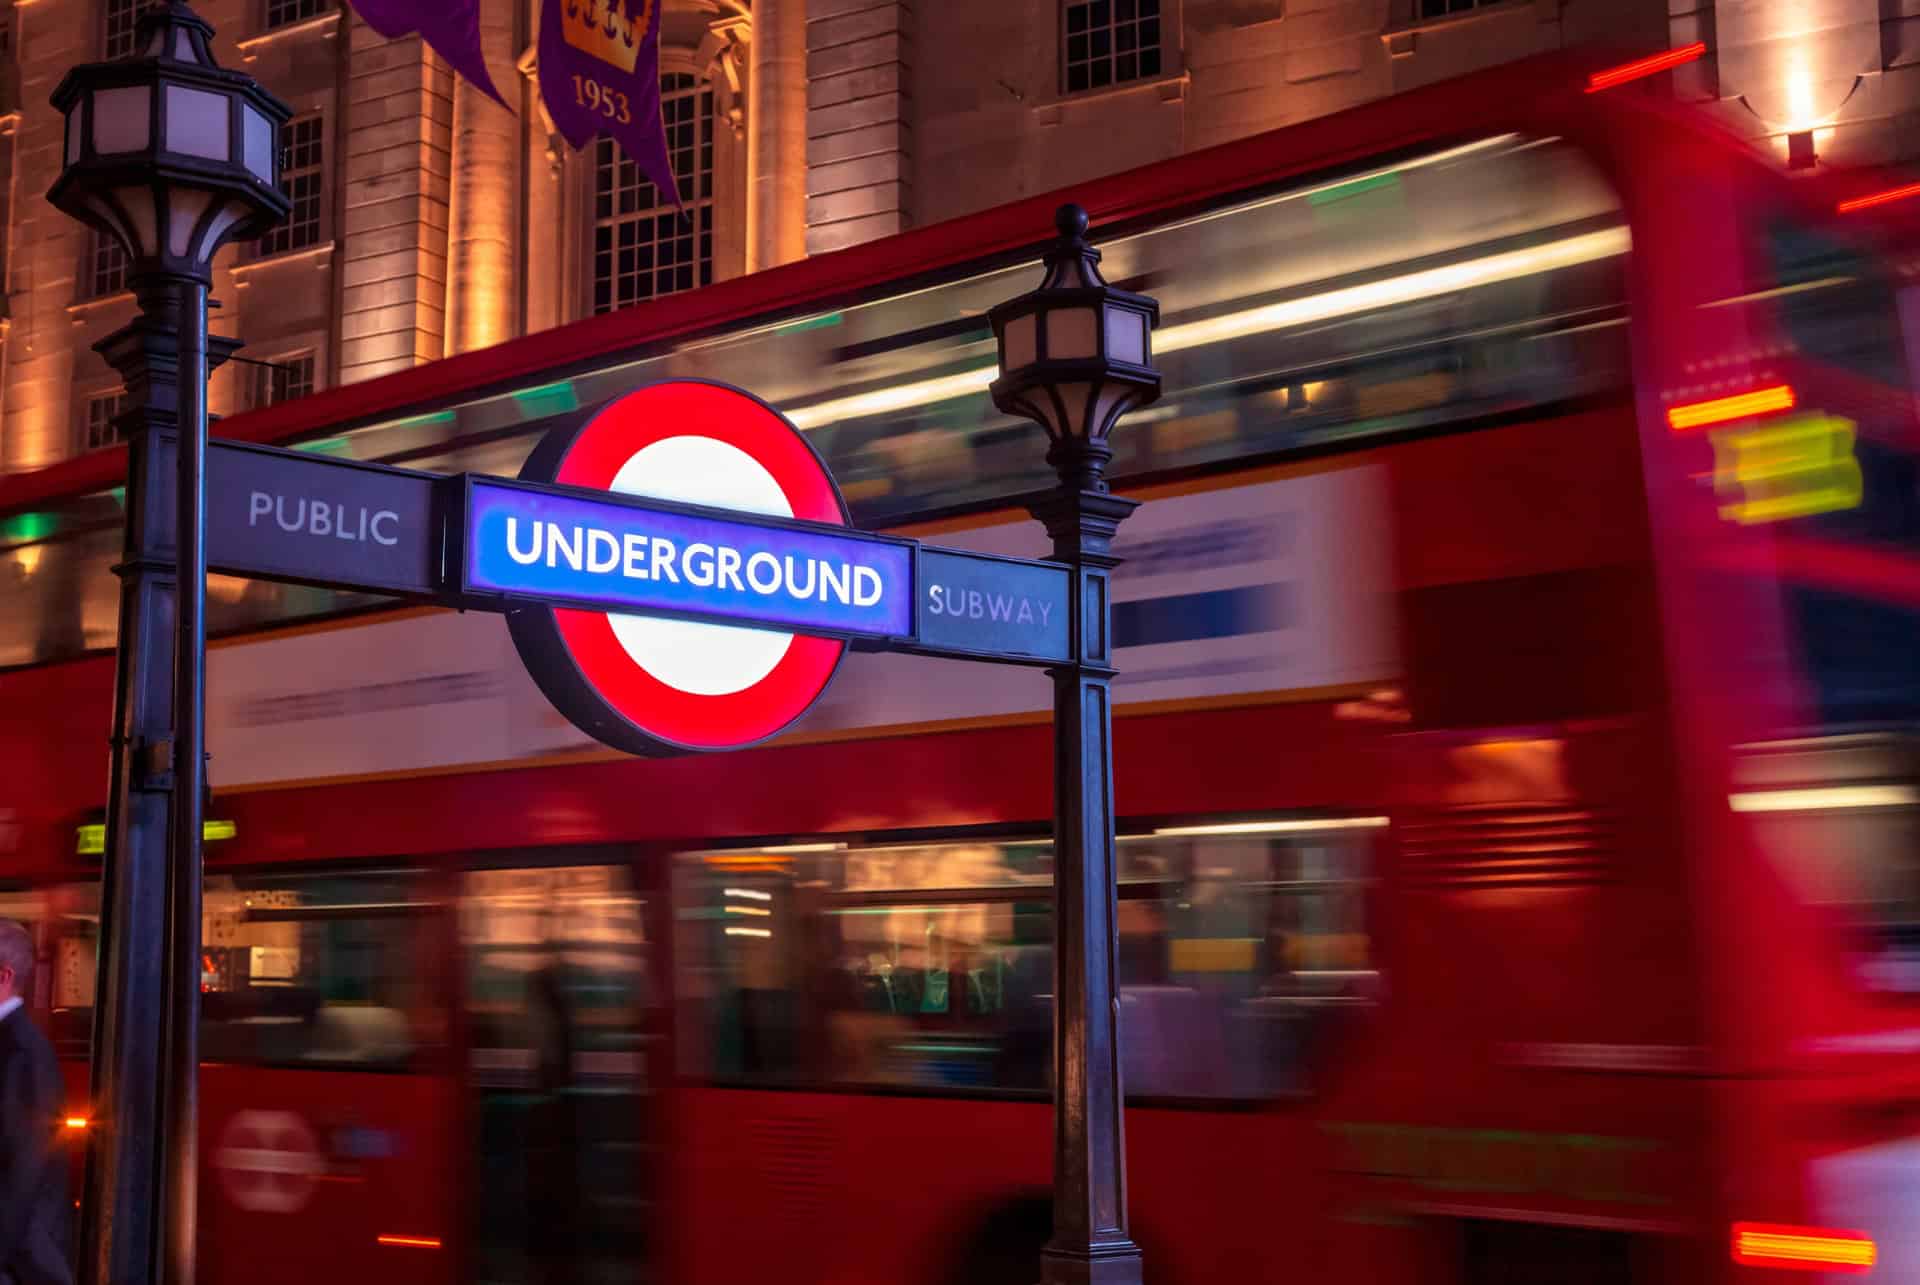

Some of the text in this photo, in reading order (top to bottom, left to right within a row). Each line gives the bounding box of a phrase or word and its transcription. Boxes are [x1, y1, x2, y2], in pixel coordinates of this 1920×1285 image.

[571, 74, 632, 124] 1953
[249, 490, 400, 546] PUBLIC
[506, 517, 883, 607] UNDERGROUND
[928, 583, 1053, 627] SUBWAY
